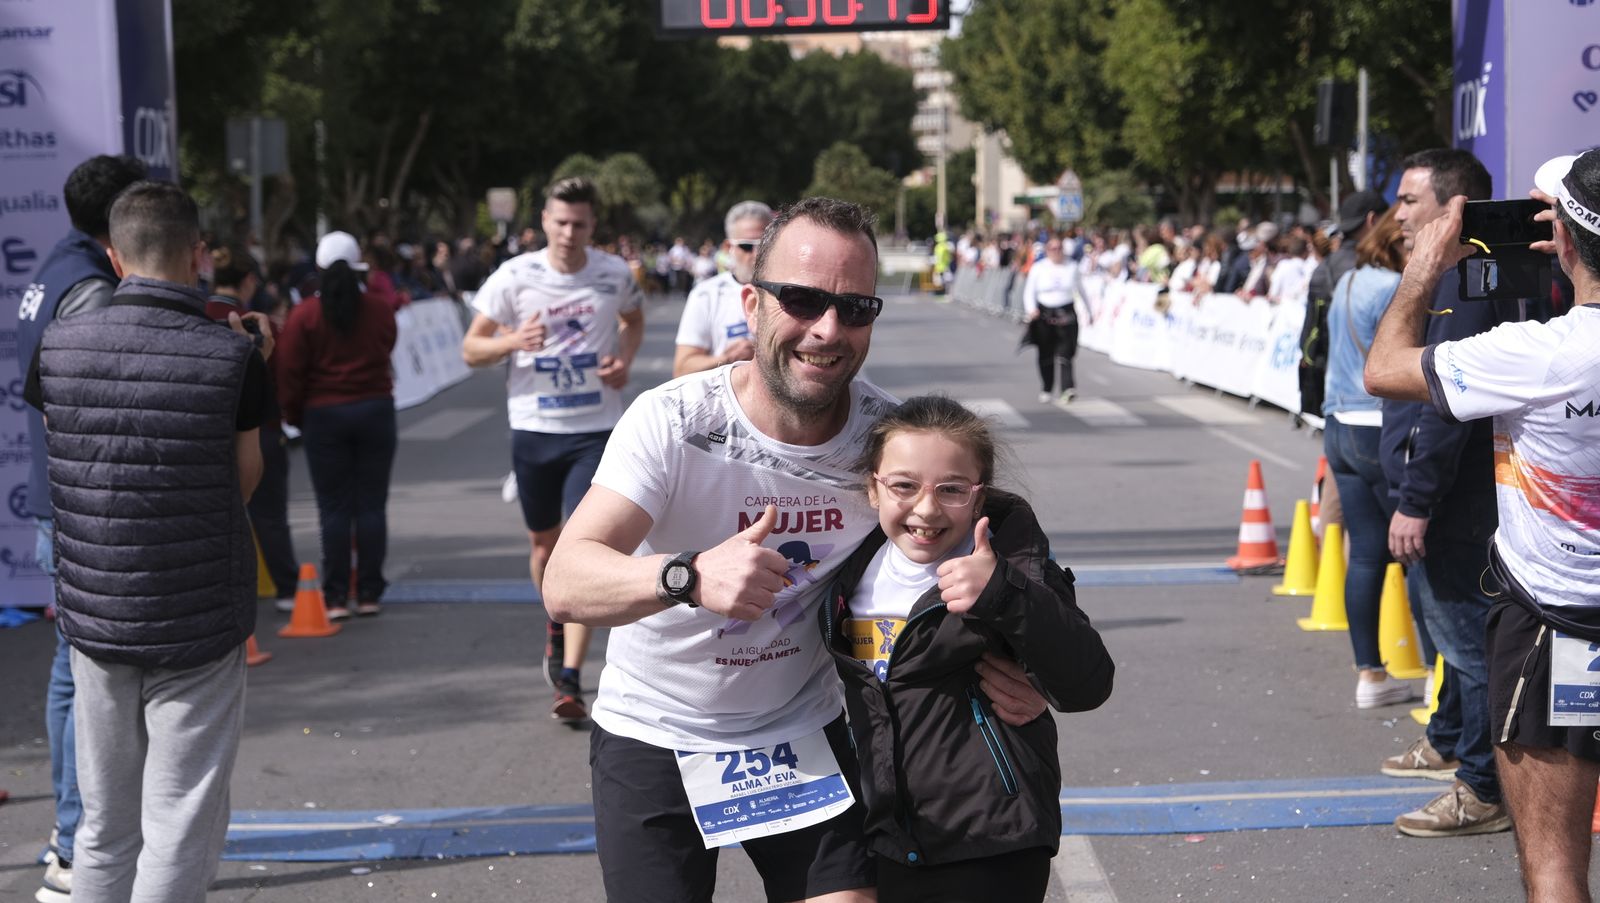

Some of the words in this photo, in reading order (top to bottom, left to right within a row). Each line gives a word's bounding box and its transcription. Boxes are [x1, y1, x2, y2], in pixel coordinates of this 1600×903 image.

[1566, 199, 1600, 228] COM
[1565, 399, 1600, 419] M
[744, 496, 801, 507] CARRERA
[804, 496, 820, 506] DE
[822, 495, 837, 504] LA
[737, 508, 844, 535] MUJER
[715, 657, 728, 666] ES
[775, 646, 801, 658] META
[731, 647, 744, 656] LA
[715, 741, 799, 784] 254
[731, 780, 762, 793] ALMA
[764, 775, 773, 785] Y
[775, 770, 797, 783] EVA
[723, 803, 740, 816] CDX
